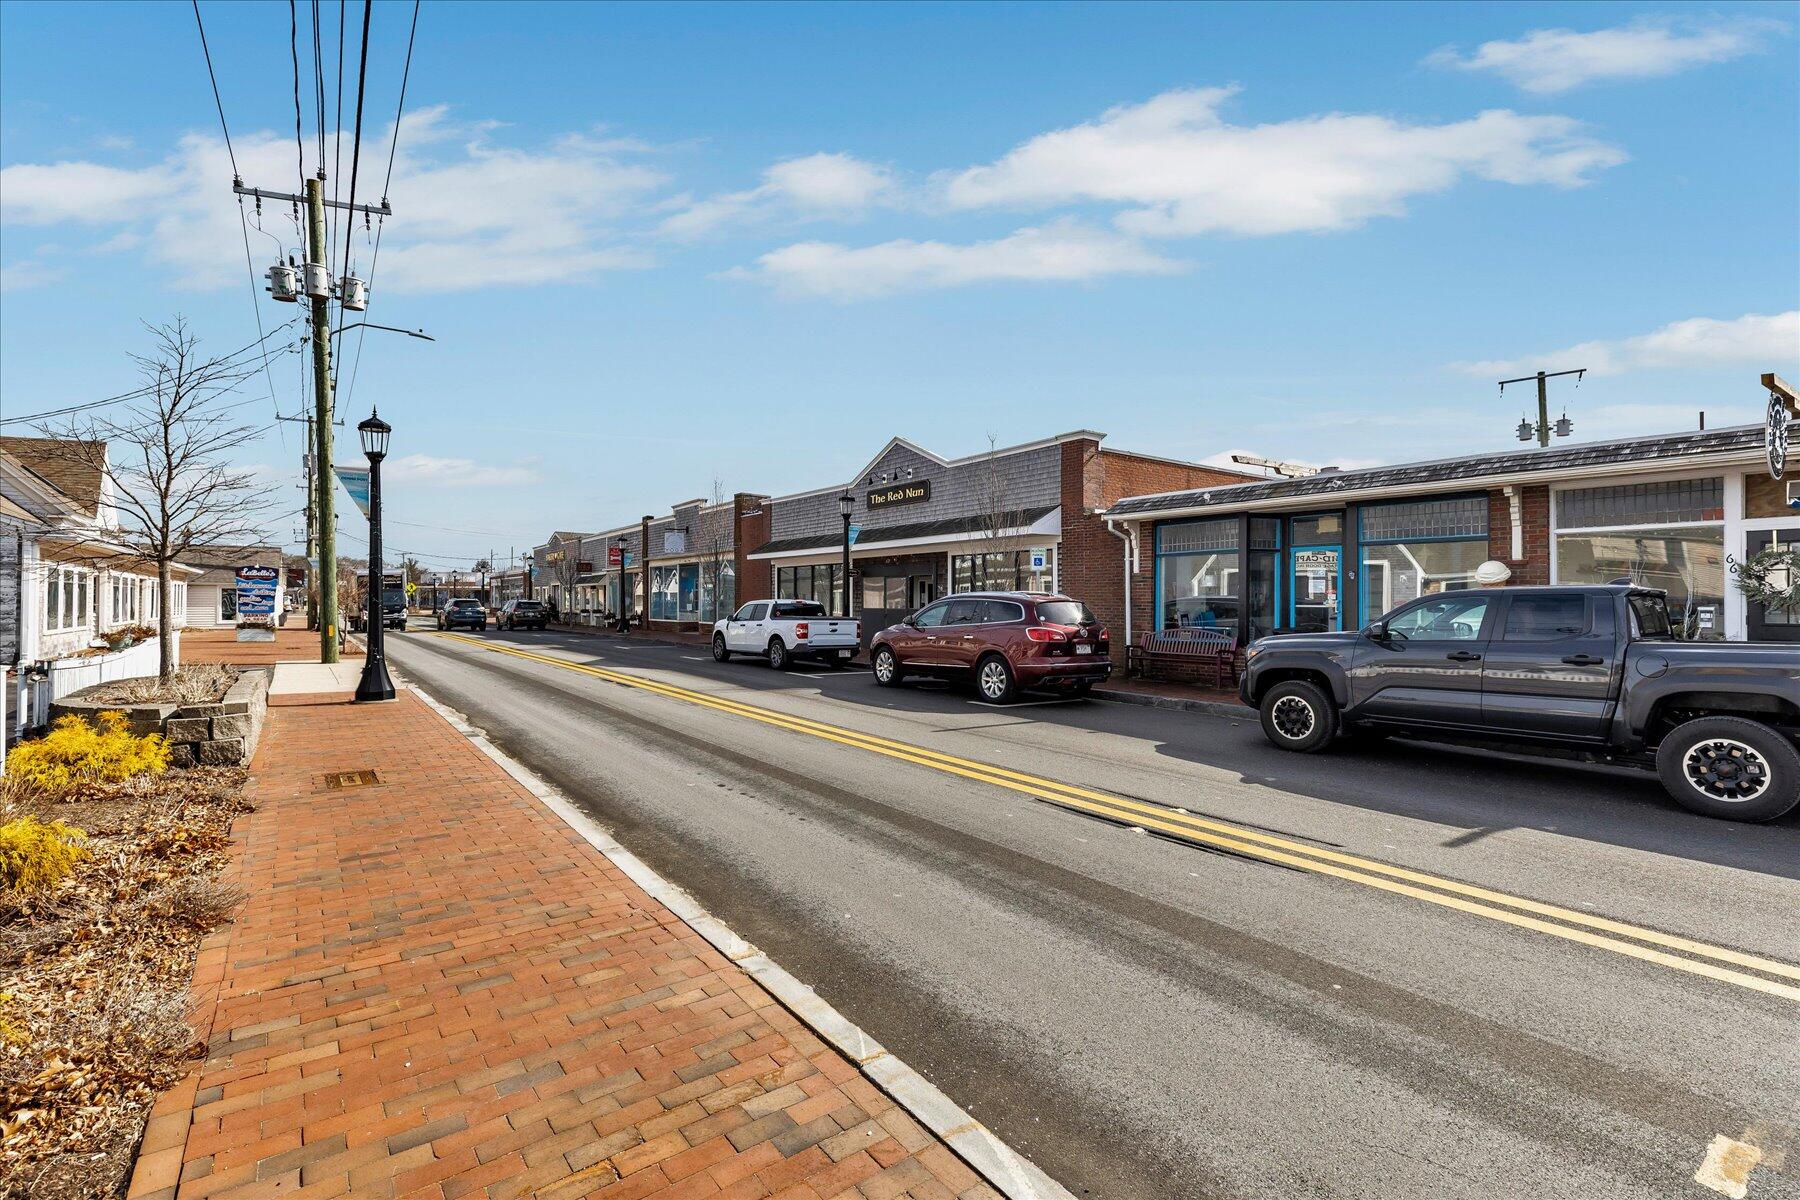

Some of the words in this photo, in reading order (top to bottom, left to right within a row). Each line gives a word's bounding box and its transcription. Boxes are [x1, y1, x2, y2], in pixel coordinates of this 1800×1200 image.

[870, 494, 886, 505] The
[887, 490, 904, 502] Red
[905, 487, 924, 499] Nun
[1725, 553, 1738, 574] 66
